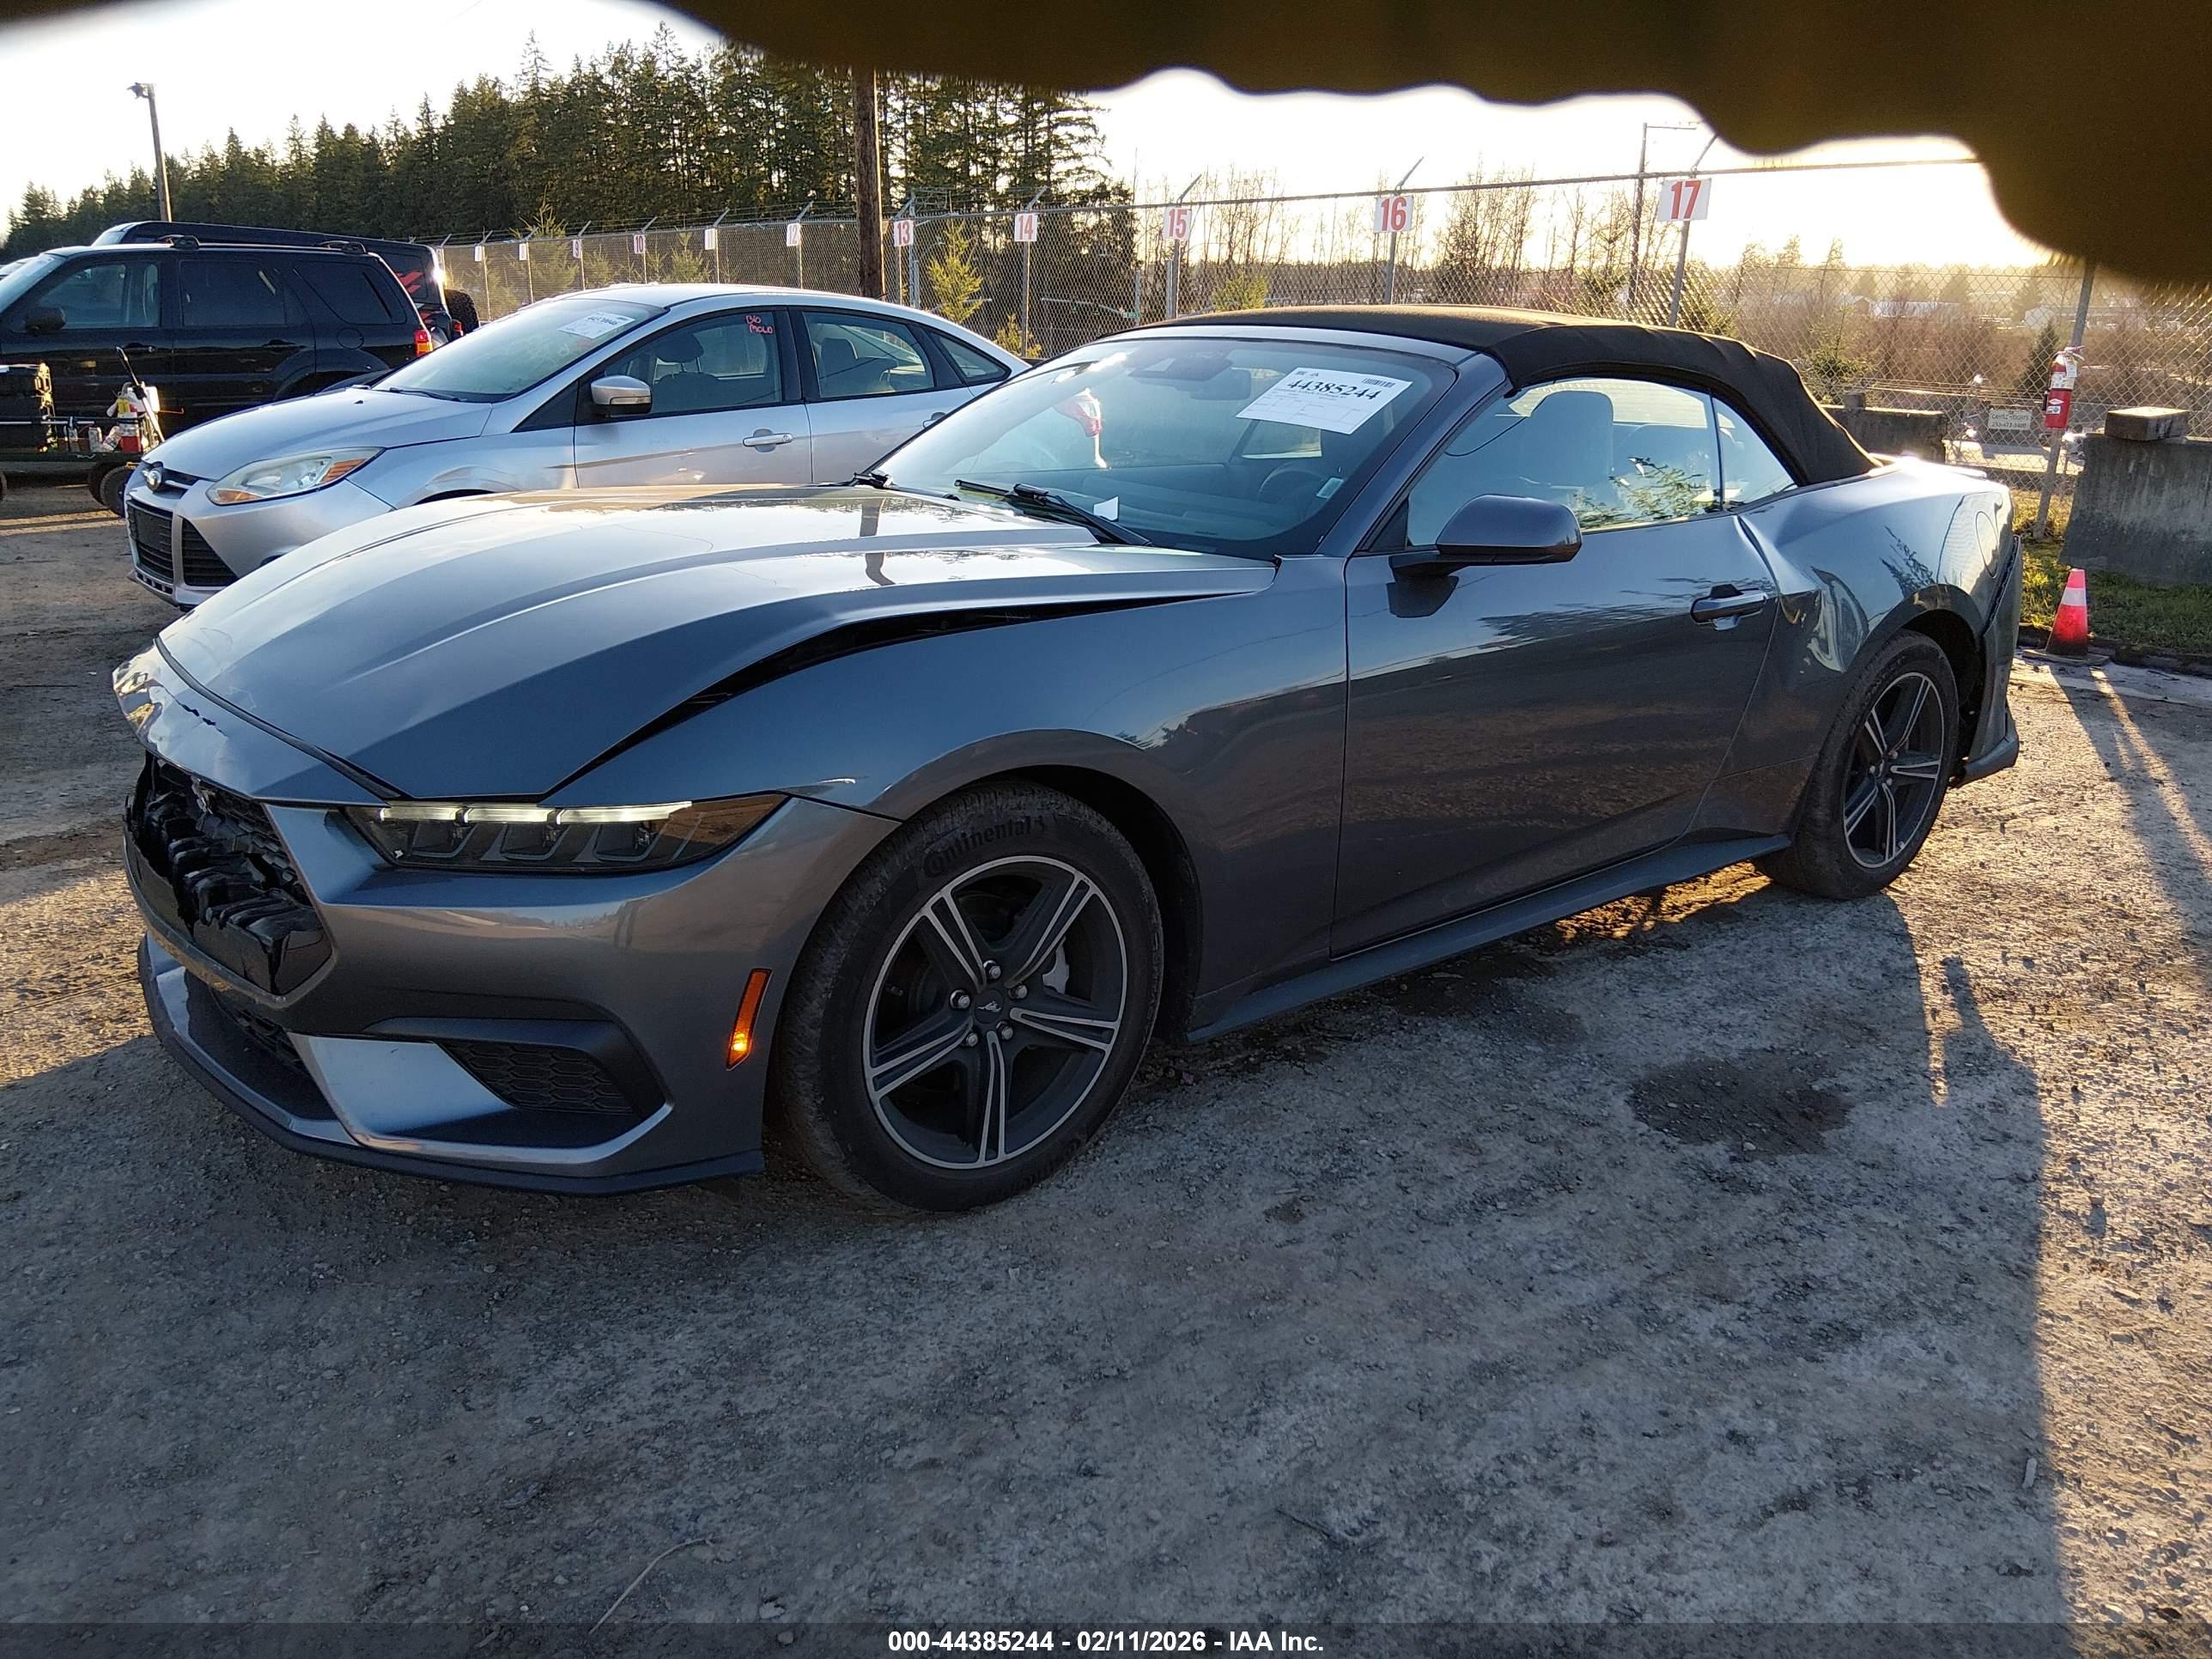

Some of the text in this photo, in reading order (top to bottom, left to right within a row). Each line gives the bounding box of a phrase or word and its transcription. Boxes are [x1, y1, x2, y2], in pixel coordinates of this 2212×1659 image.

[1671, 180, 1702, 220] 17
[1169, 209, 1187, 239] 15
[1381, 197, 1407, 231] 16
[788, 225, 799, 244] 12
[896, 221, 911, 246] 13
[1017, 215, 1035, 240] 14
[635, 235, 644, 254] 10
[1287, 379, 1382, 400] 44385244
[922, 815, 1032, 878] Continental
